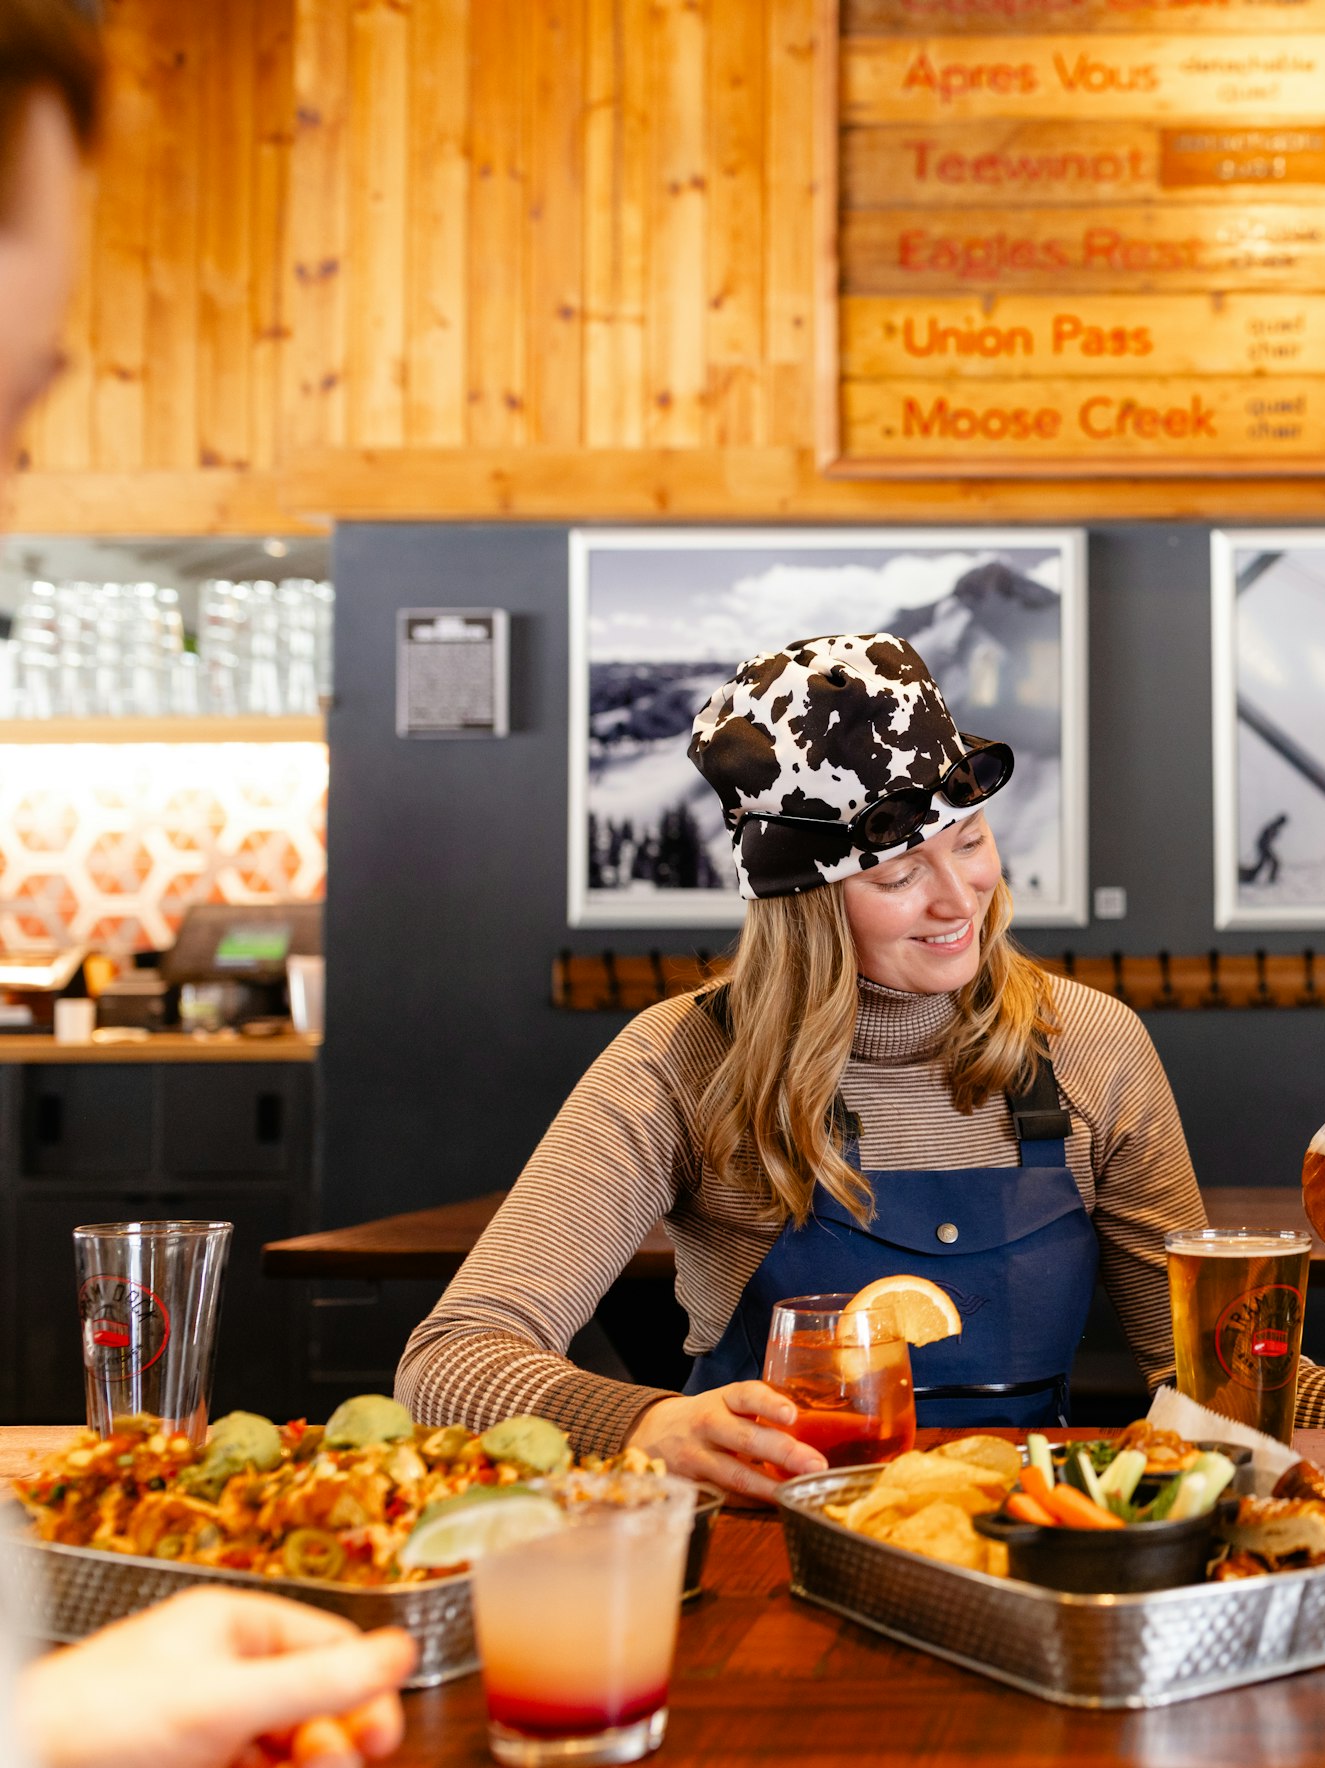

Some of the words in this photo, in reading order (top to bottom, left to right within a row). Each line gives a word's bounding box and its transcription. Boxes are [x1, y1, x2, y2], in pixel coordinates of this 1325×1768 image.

[902, 50, 1040, 103] Apres
[1053, 52, 1160, 93] Vous
[902, 139, 1148, 185] Teewinot
[900, 229, 1069, 281] Eagles
[1083, 227, 1206, 271] Rest
[902, 315, 1033, 357] Union
[1052, 314, 1152, 357] Pass
[902, 396, 1061, 440] Moose
[1080, 396, 1217, 440] Creek
